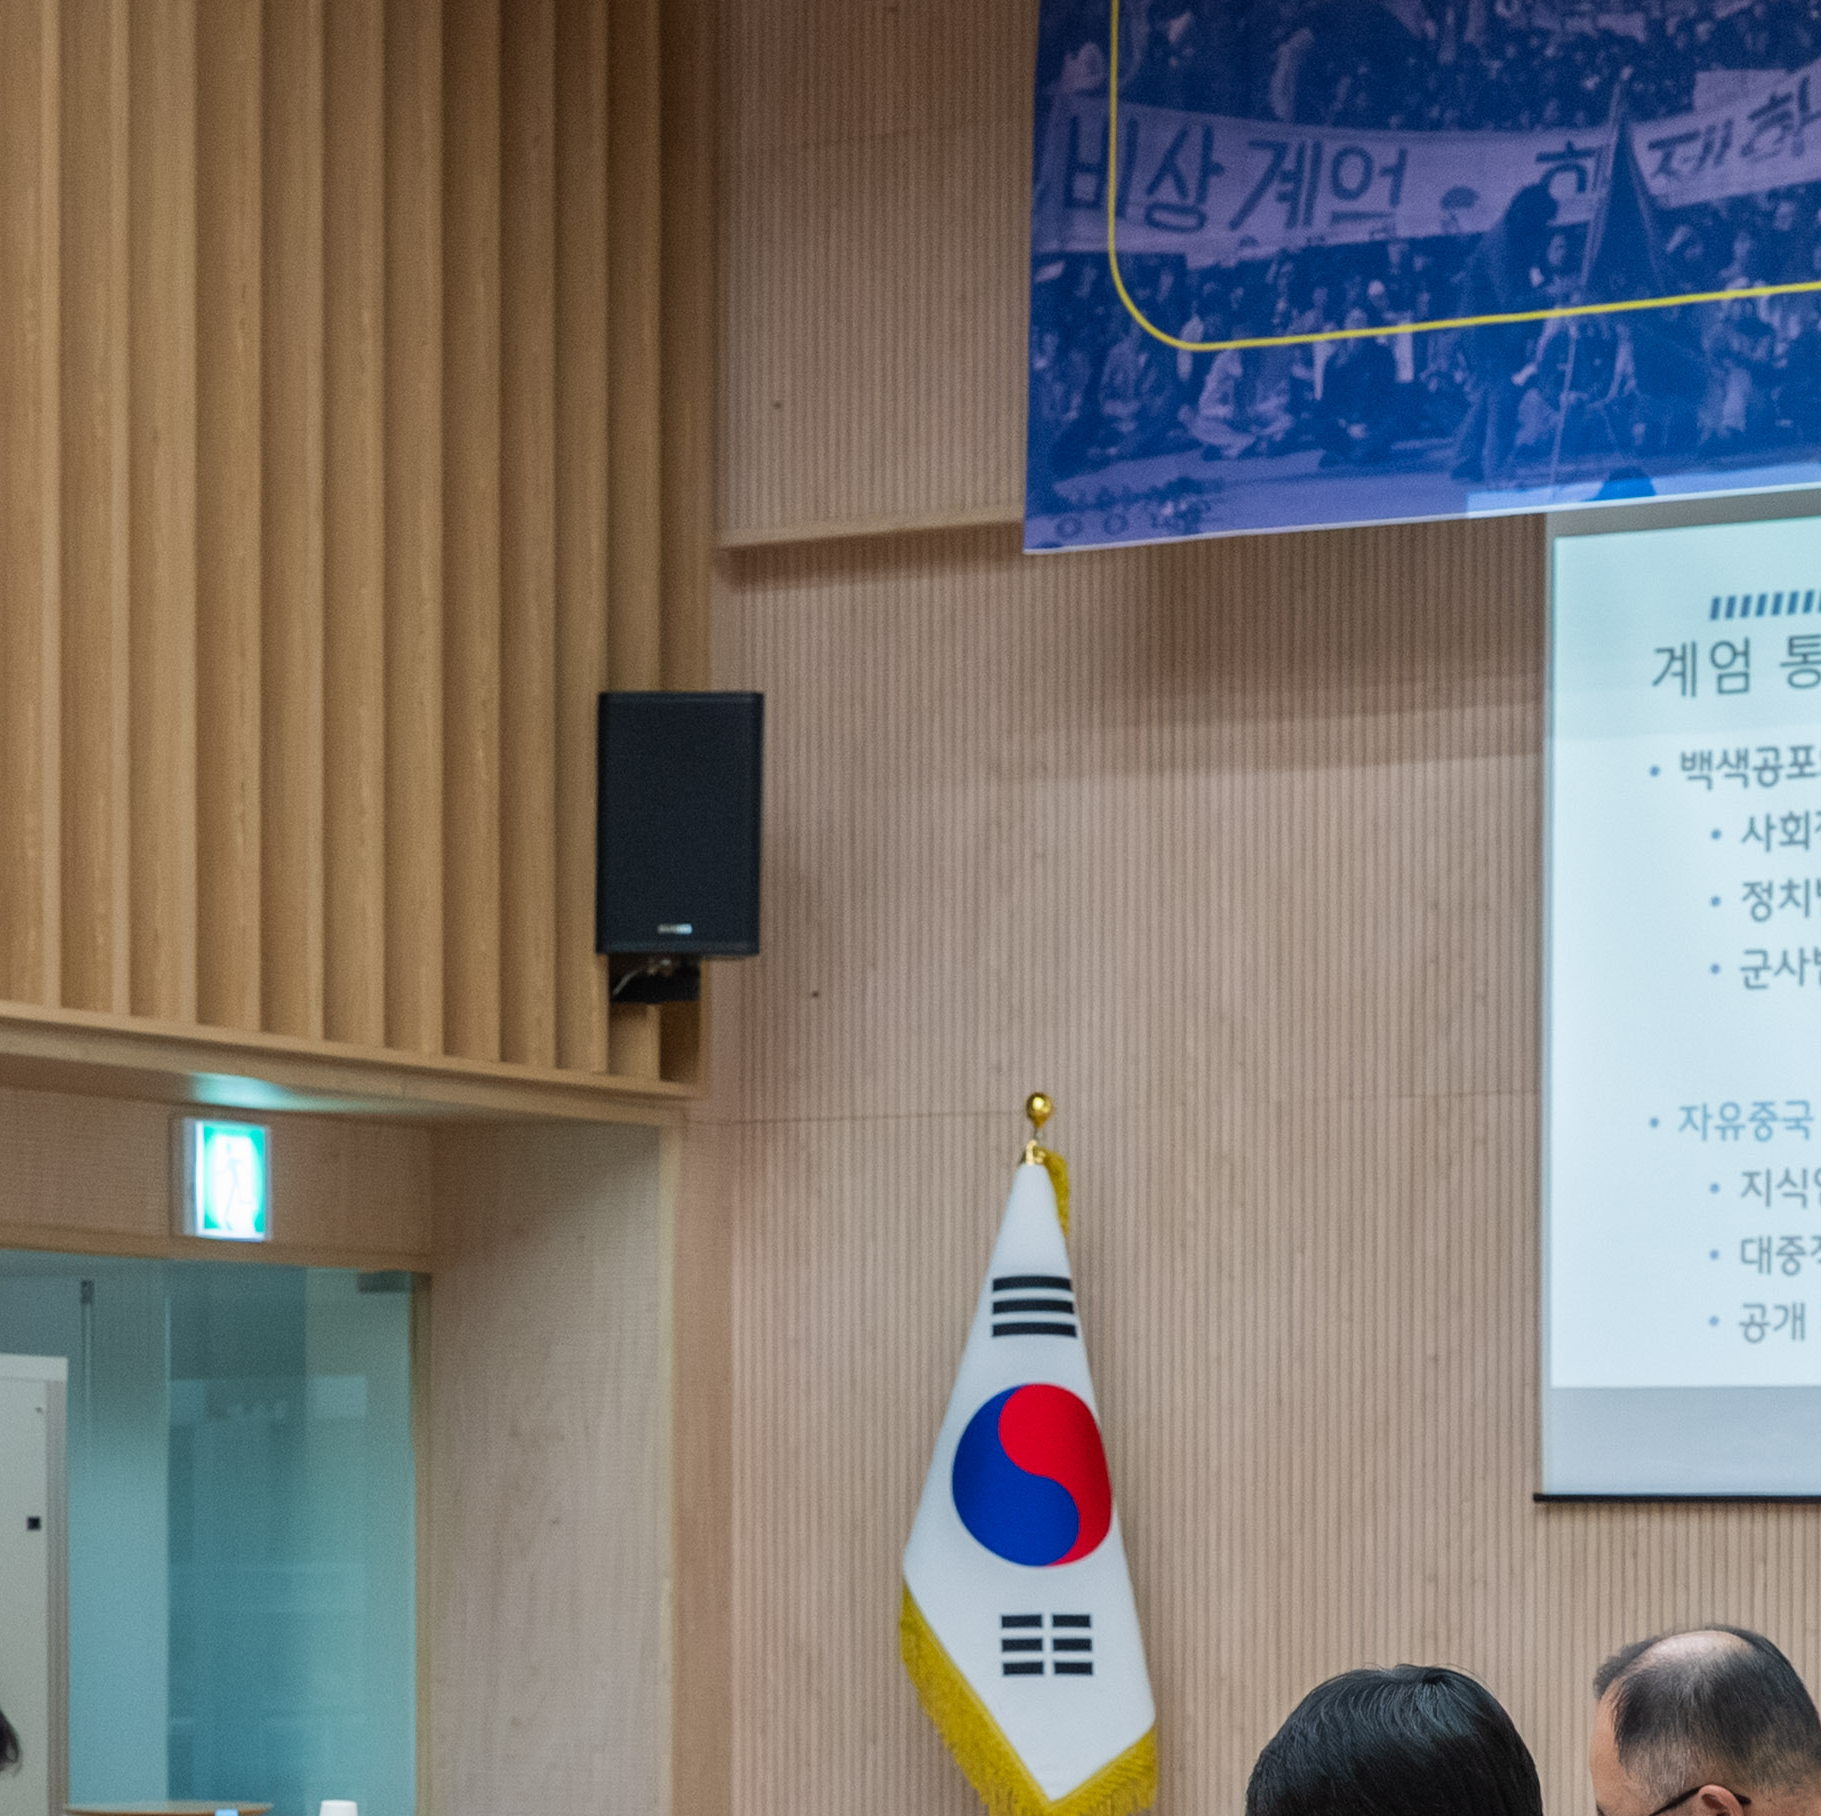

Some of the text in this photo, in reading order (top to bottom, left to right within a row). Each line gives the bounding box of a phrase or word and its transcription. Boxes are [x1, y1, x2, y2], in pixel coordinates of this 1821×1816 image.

[1651, 635, 1752, 699] 계엄
[1677, 1098, 1815, 1144] 자유중국
[1737, 1300, 1807, 1345] 공개
